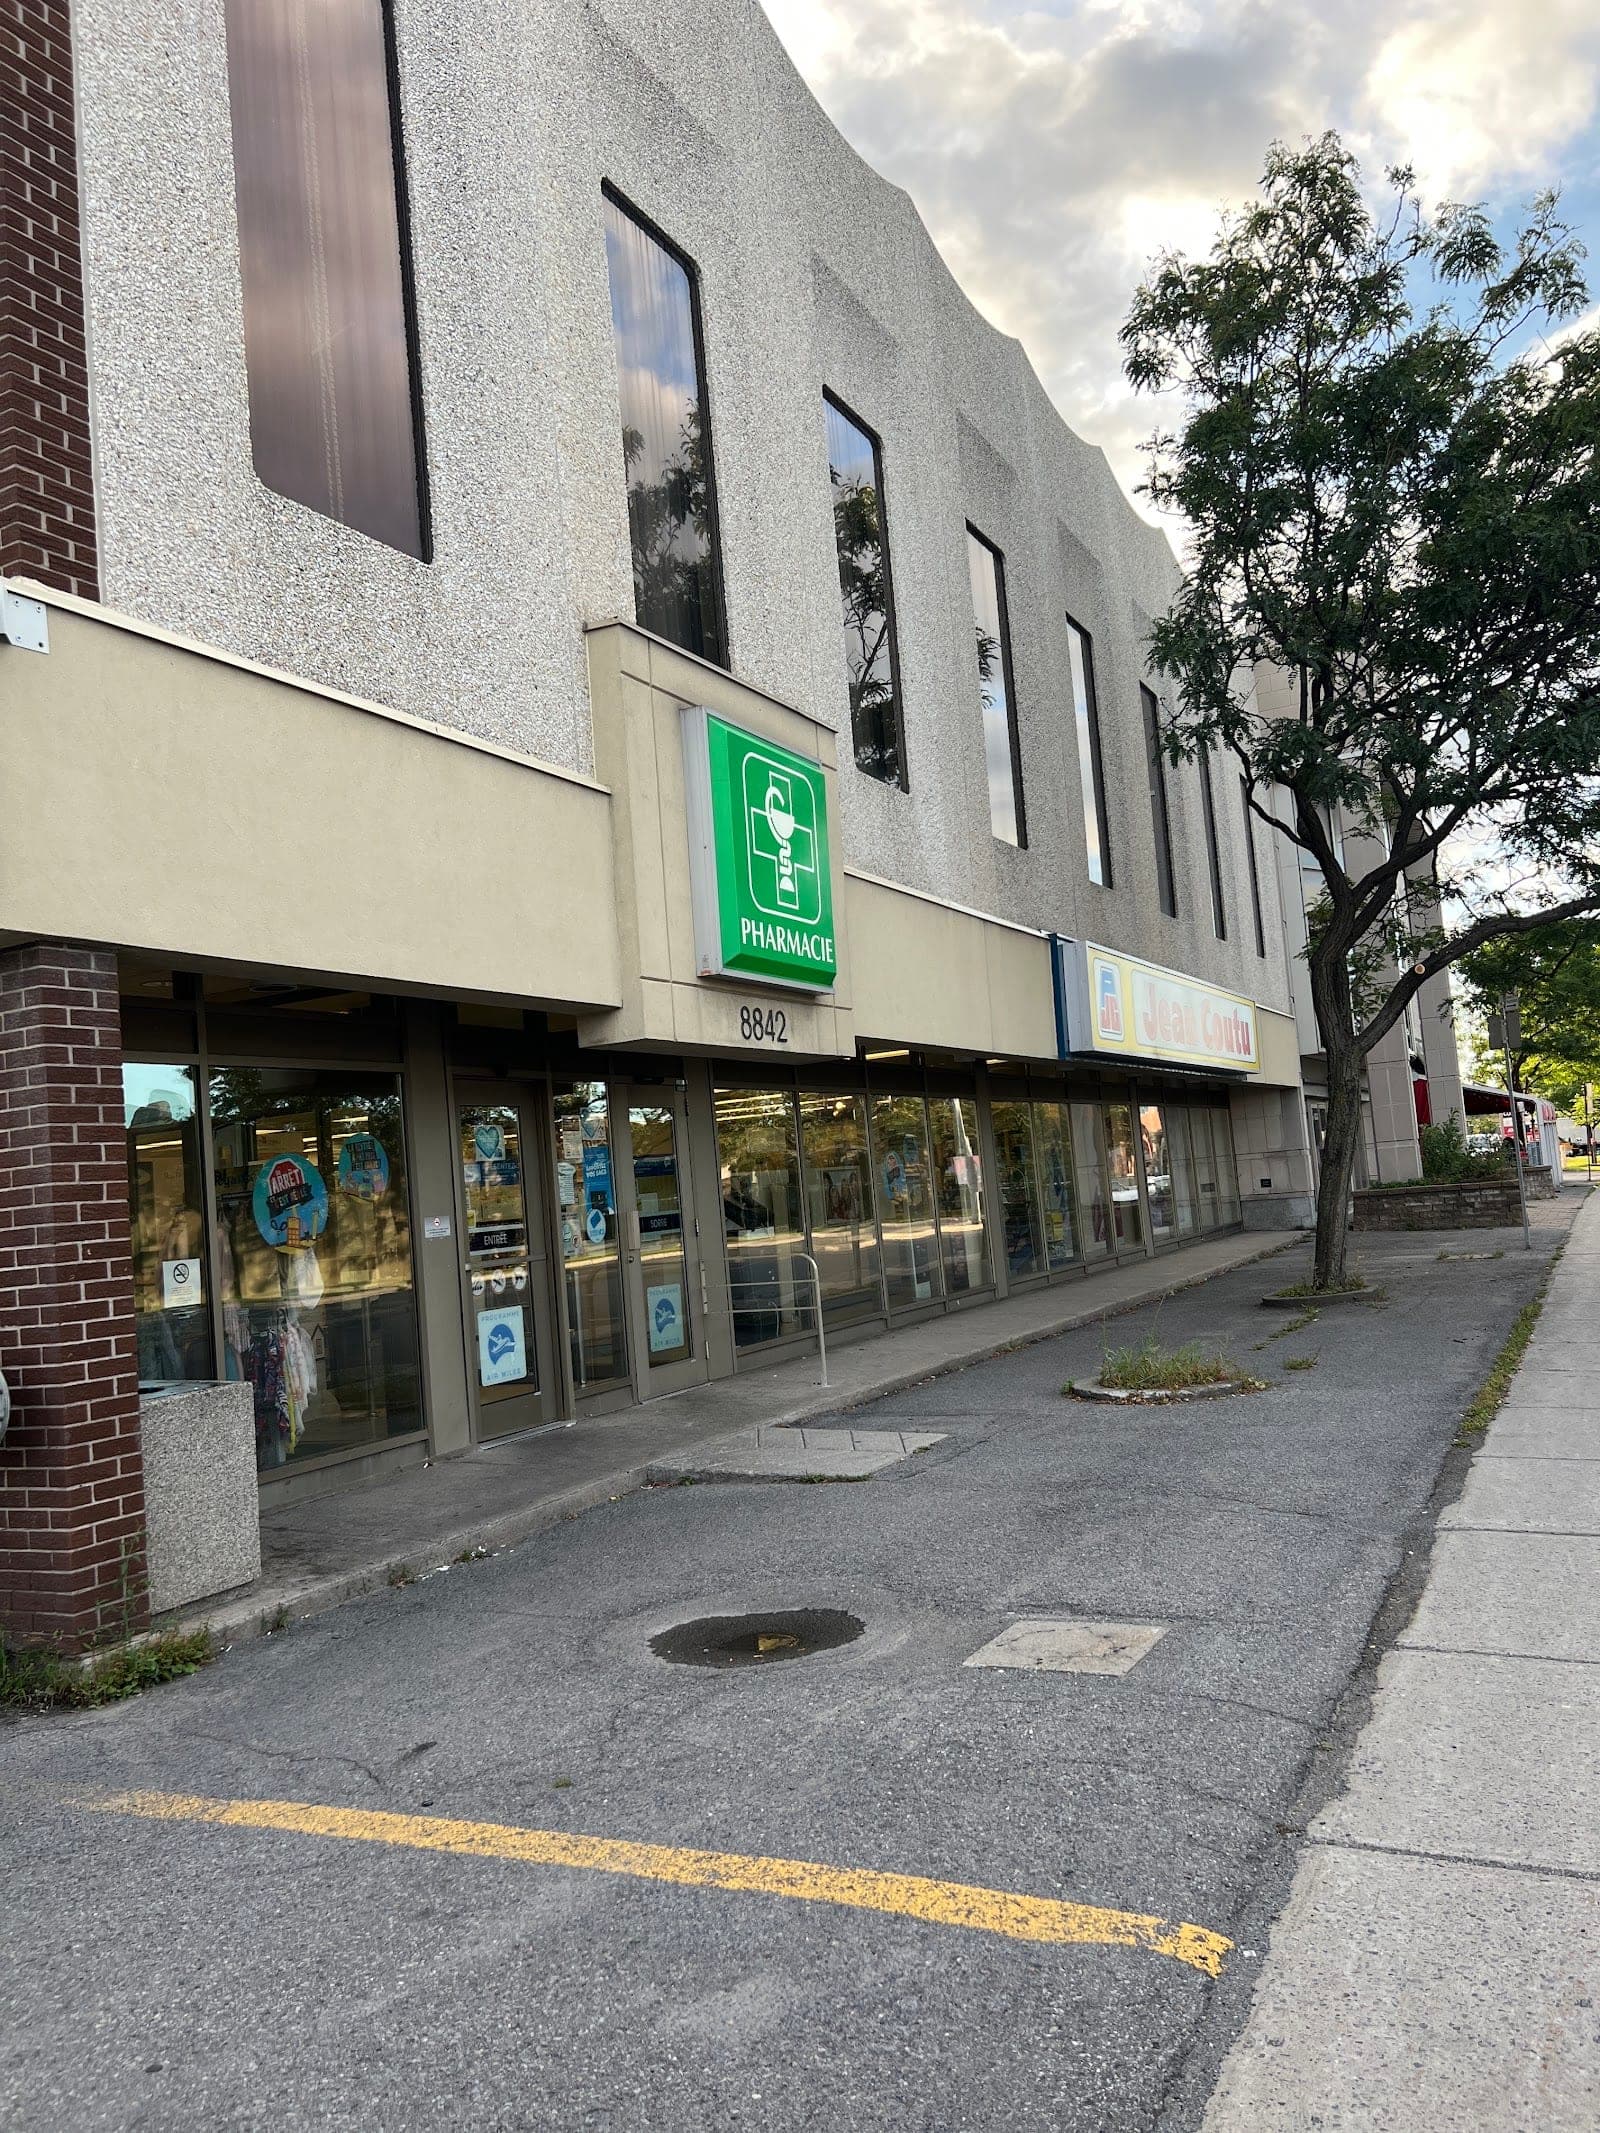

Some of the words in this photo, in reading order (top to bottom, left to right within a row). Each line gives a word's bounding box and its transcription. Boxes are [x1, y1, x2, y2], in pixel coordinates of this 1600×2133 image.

[741, 917, 834, 963] PHARMACIE
[740, 1005, 788, 1043] 8842
[1142, 982, 1198, 1045] Jean
[1200, 997, 1251, 1056] Coutu
[483, 1231, 508, 1246] ENTRÉE
